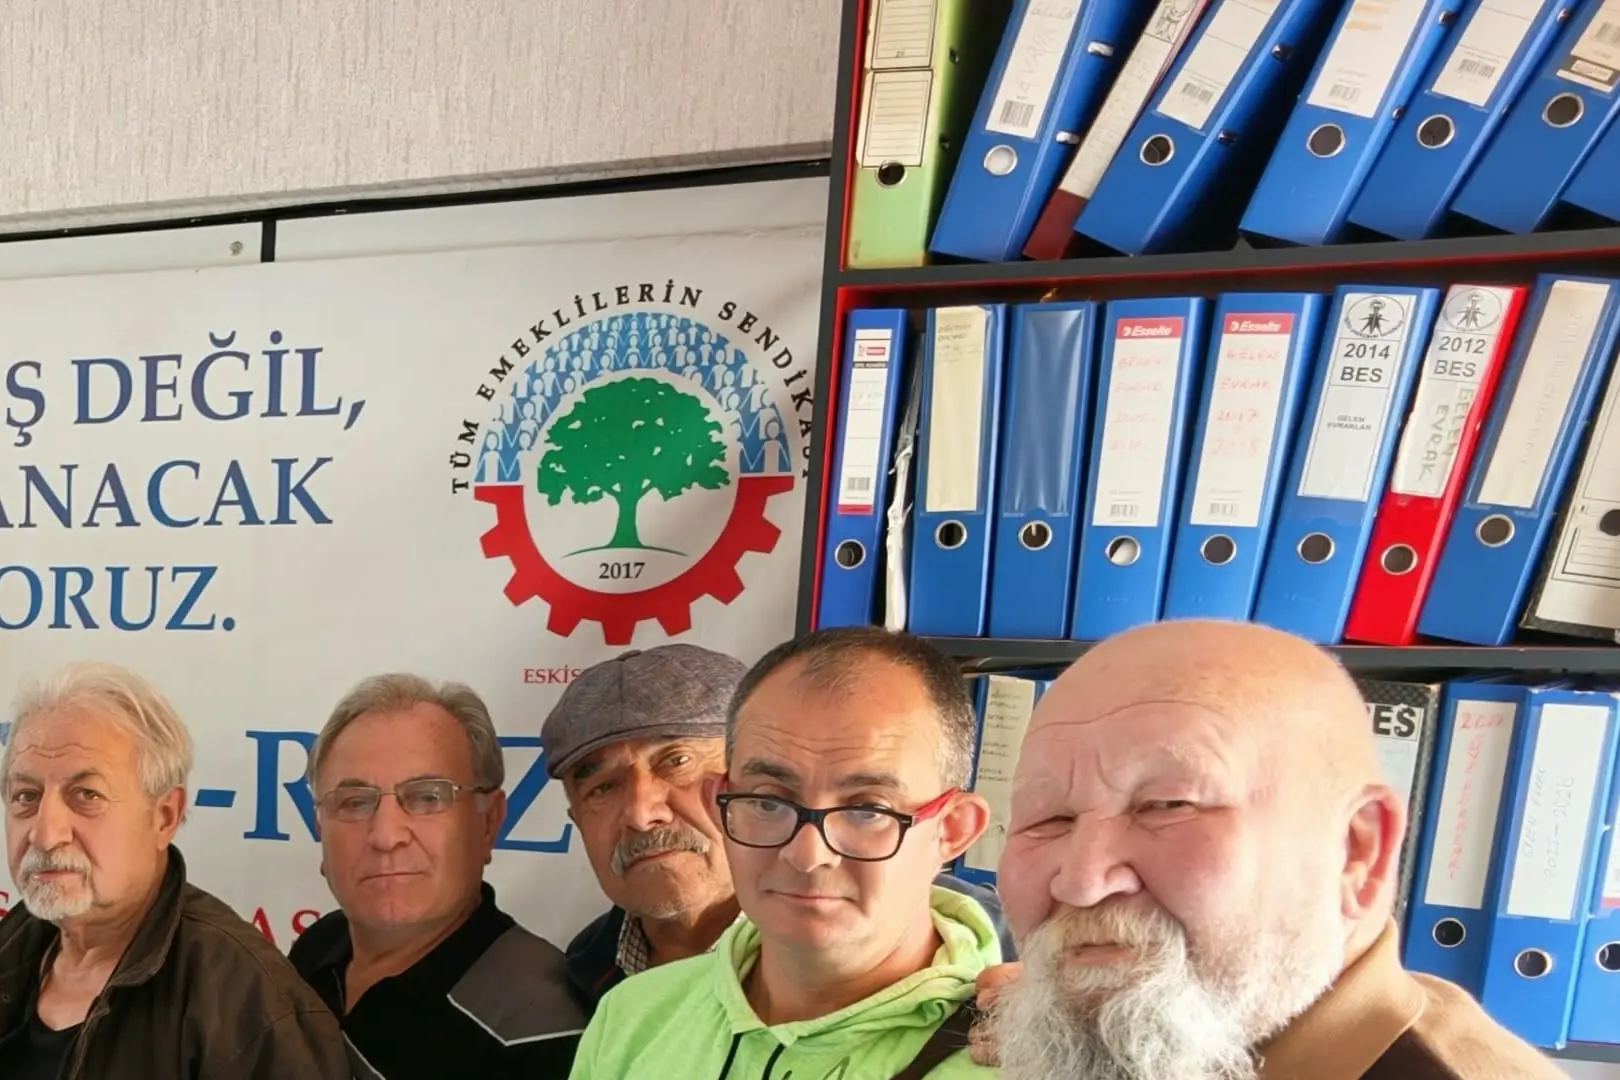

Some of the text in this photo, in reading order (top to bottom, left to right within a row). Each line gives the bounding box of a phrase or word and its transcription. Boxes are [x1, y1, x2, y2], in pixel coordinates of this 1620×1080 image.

[1344, 343, 1390, 359] 2014
[1438, 336, 1486, 355] 2012
[1340, 367, 1383, 382] BES
[1434, 359, 1477, 377] BES
[70, 330, 368, 431] DEĞİL,
[449, 419, 479, 494] TÜM
[477, 279, 703, 401] EMEKLİLERİN
[598, 561, 646, 580] 2017
[1366, 705, 1416, 737] ES
